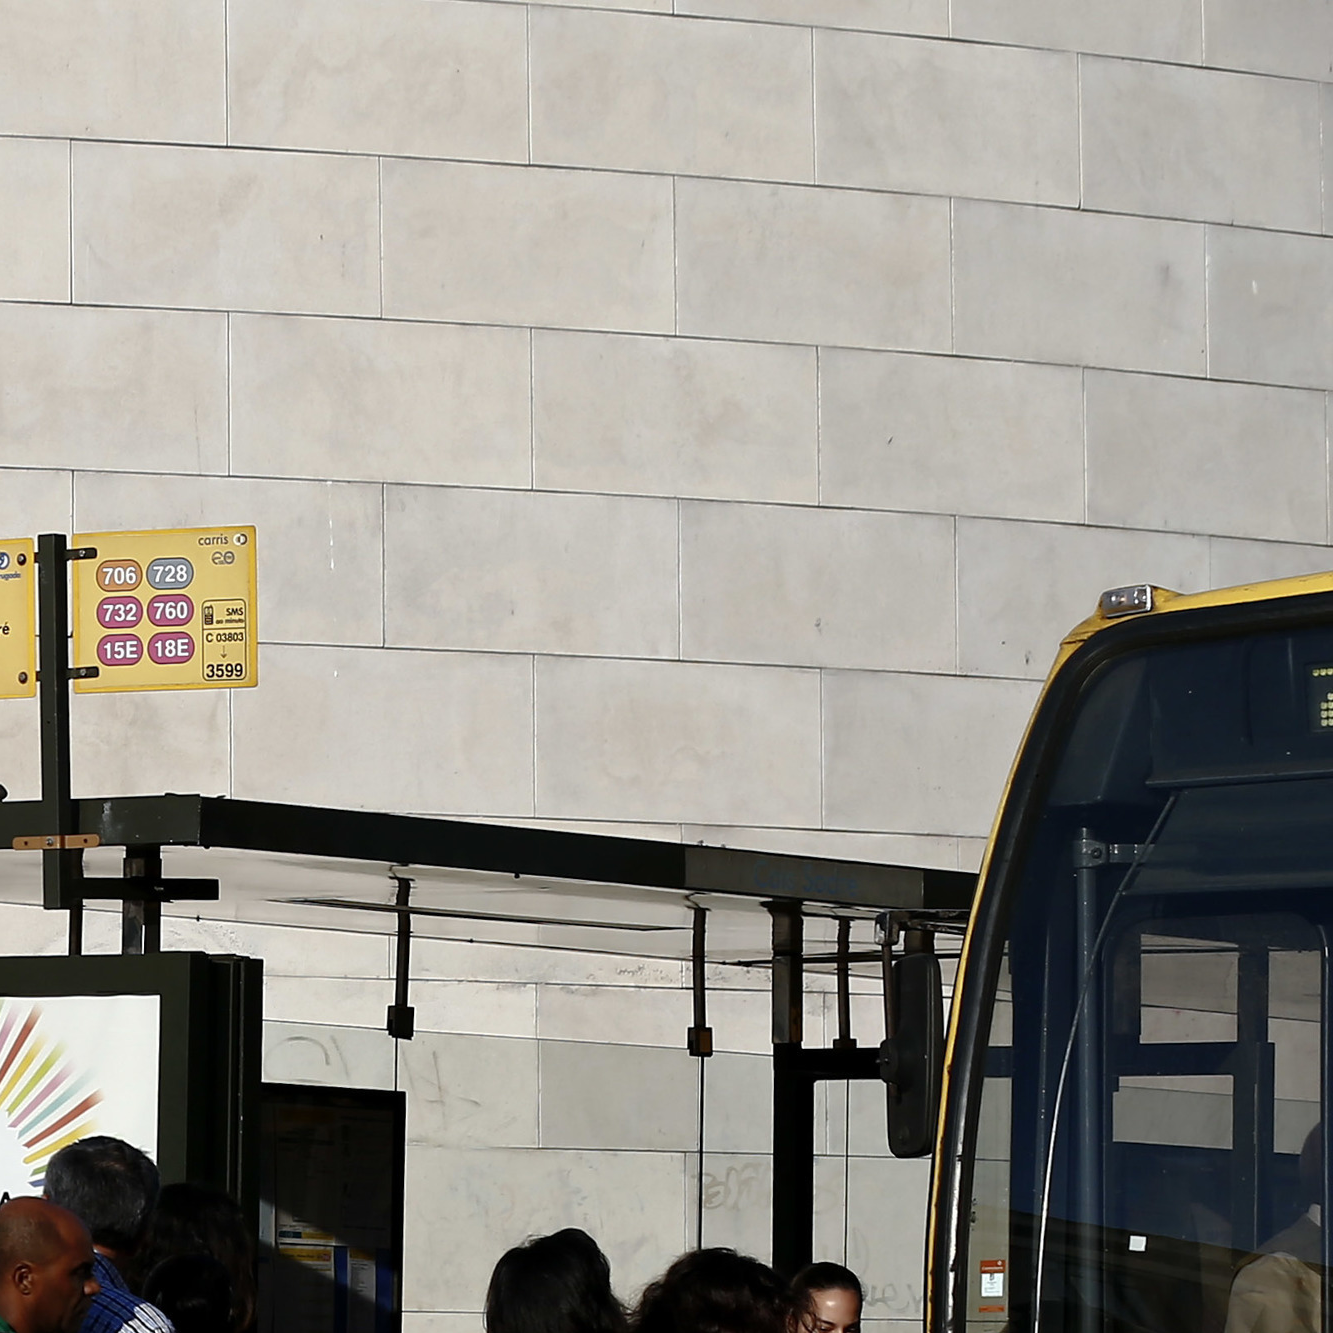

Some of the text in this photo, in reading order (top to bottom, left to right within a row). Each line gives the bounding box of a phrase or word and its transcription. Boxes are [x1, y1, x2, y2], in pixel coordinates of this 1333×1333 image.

[198, 534, 229, 545] carris
[102, 565, 187, 585] 706 728
[102, 601, 188, 622] 732 760
[225, 607, 244, 616] SMS
[206, 632, 243, 642] C 03803
[103, 638, 189, 660] 15E 18E
[206, 663, 243, 677] 3599
